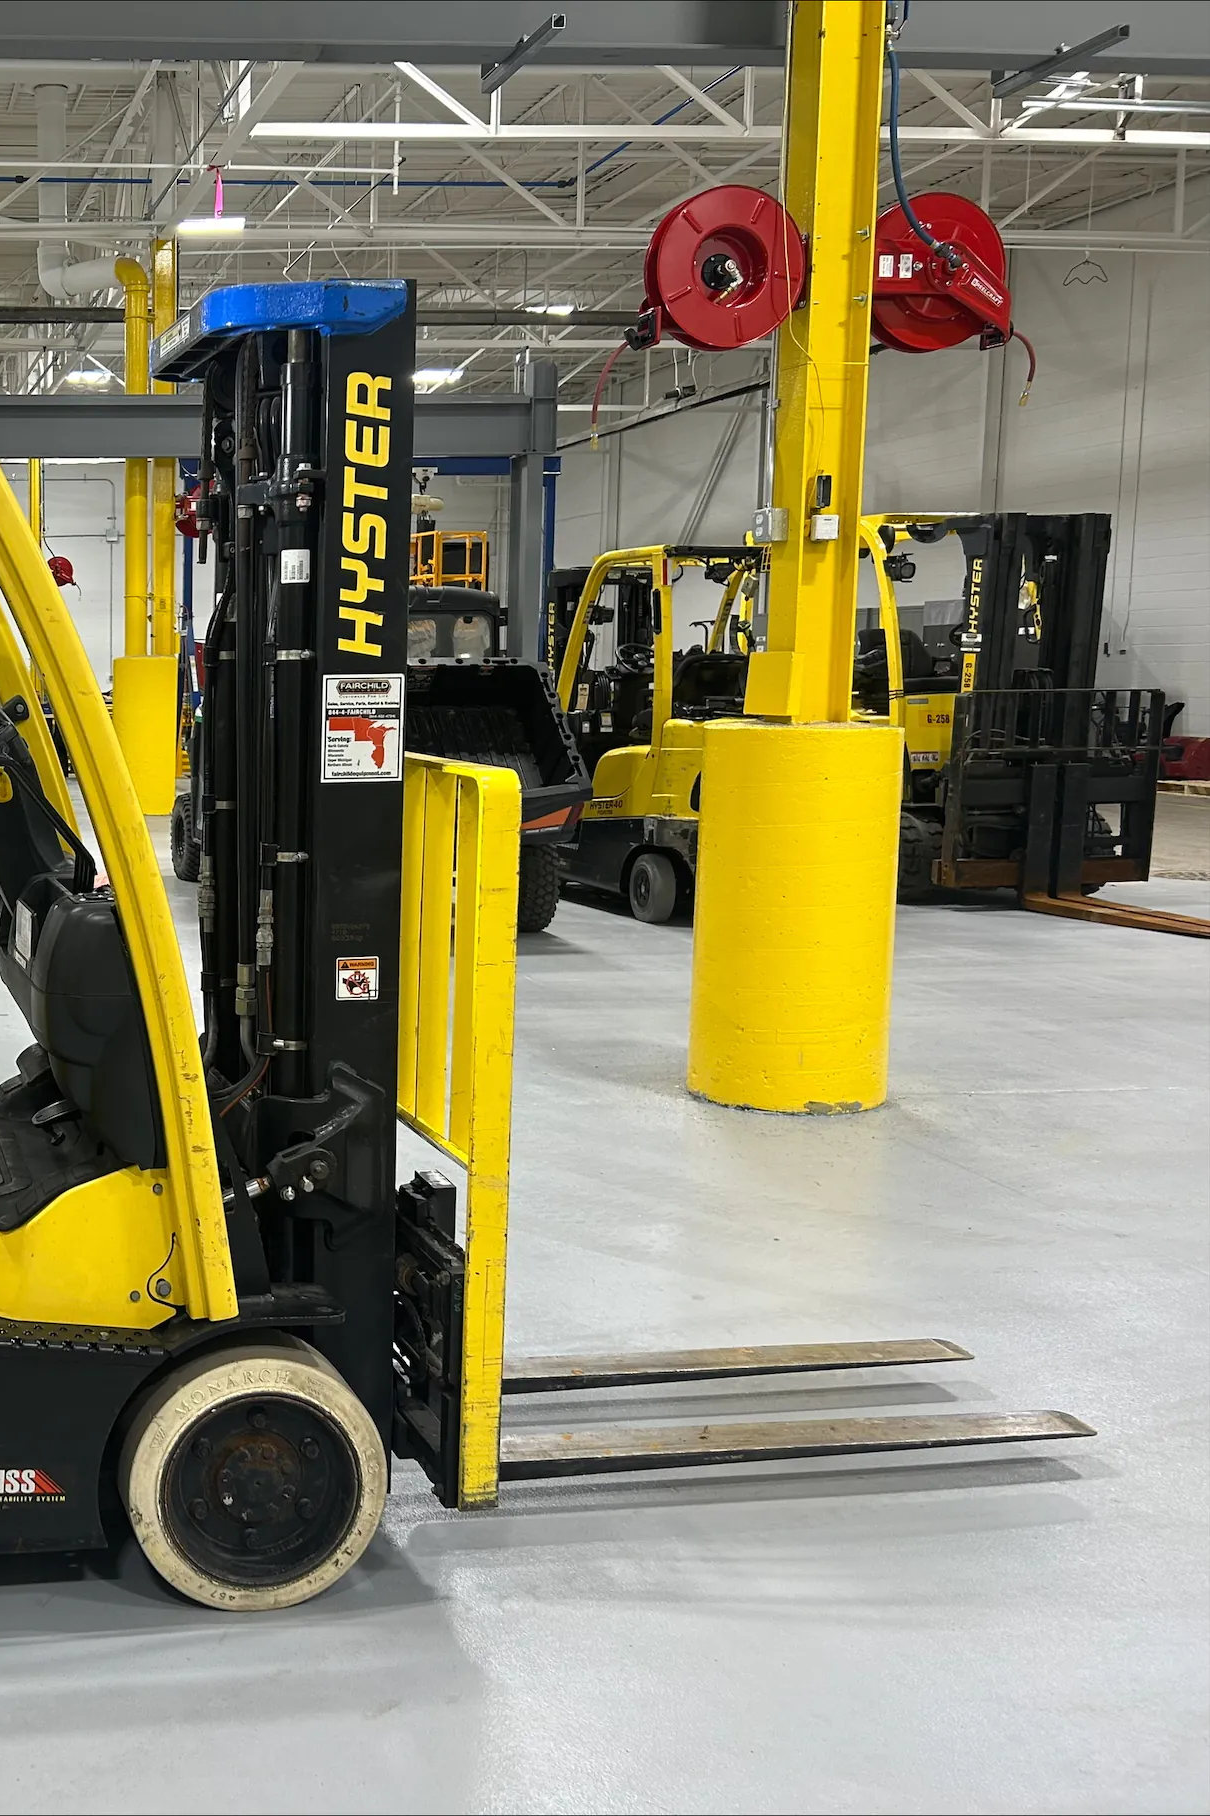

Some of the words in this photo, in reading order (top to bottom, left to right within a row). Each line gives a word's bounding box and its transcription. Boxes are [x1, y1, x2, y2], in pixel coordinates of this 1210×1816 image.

[338, 371, 393, 657] HYSTER
[968, 558, 983, 634] HYSTER
[547, 602, 556, 671] HYSTER
[340, 682, 389, 690] FAIRCHILD
[963, 662, 973, 688] G-258
[927, 715, 950, 724] G-258
[174, 1367, 291, 1420] MONARCH
